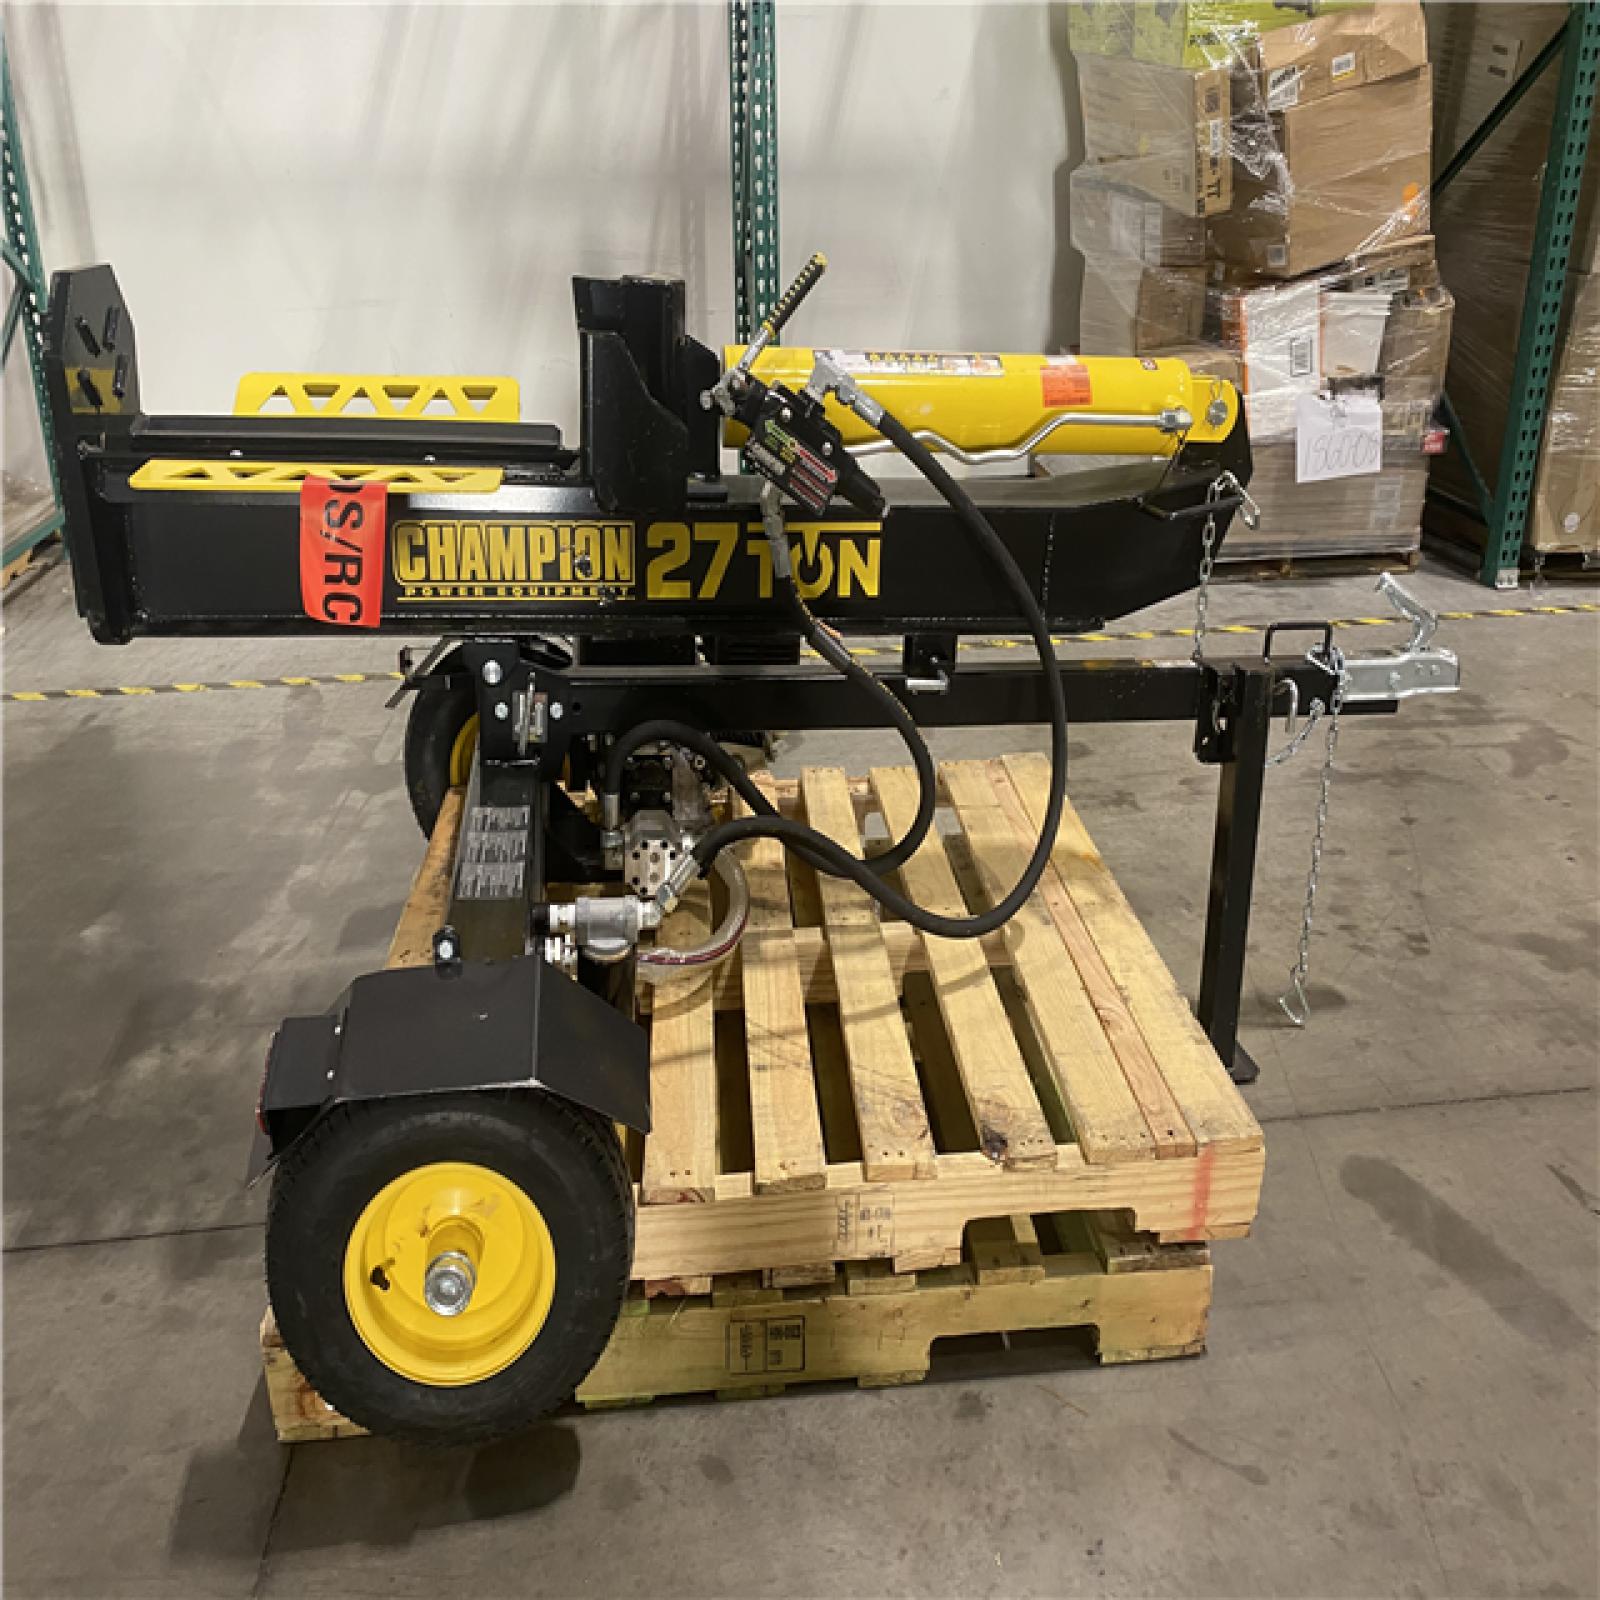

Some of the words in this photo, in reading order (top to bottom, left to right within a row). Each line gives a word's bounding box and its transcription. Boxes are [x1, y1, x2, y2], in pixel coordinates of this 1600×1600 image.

[397, 525, 632, 581] CHAMPION
[646, 521, 740, 599] 27
[746, 520, 882, 599] TON
